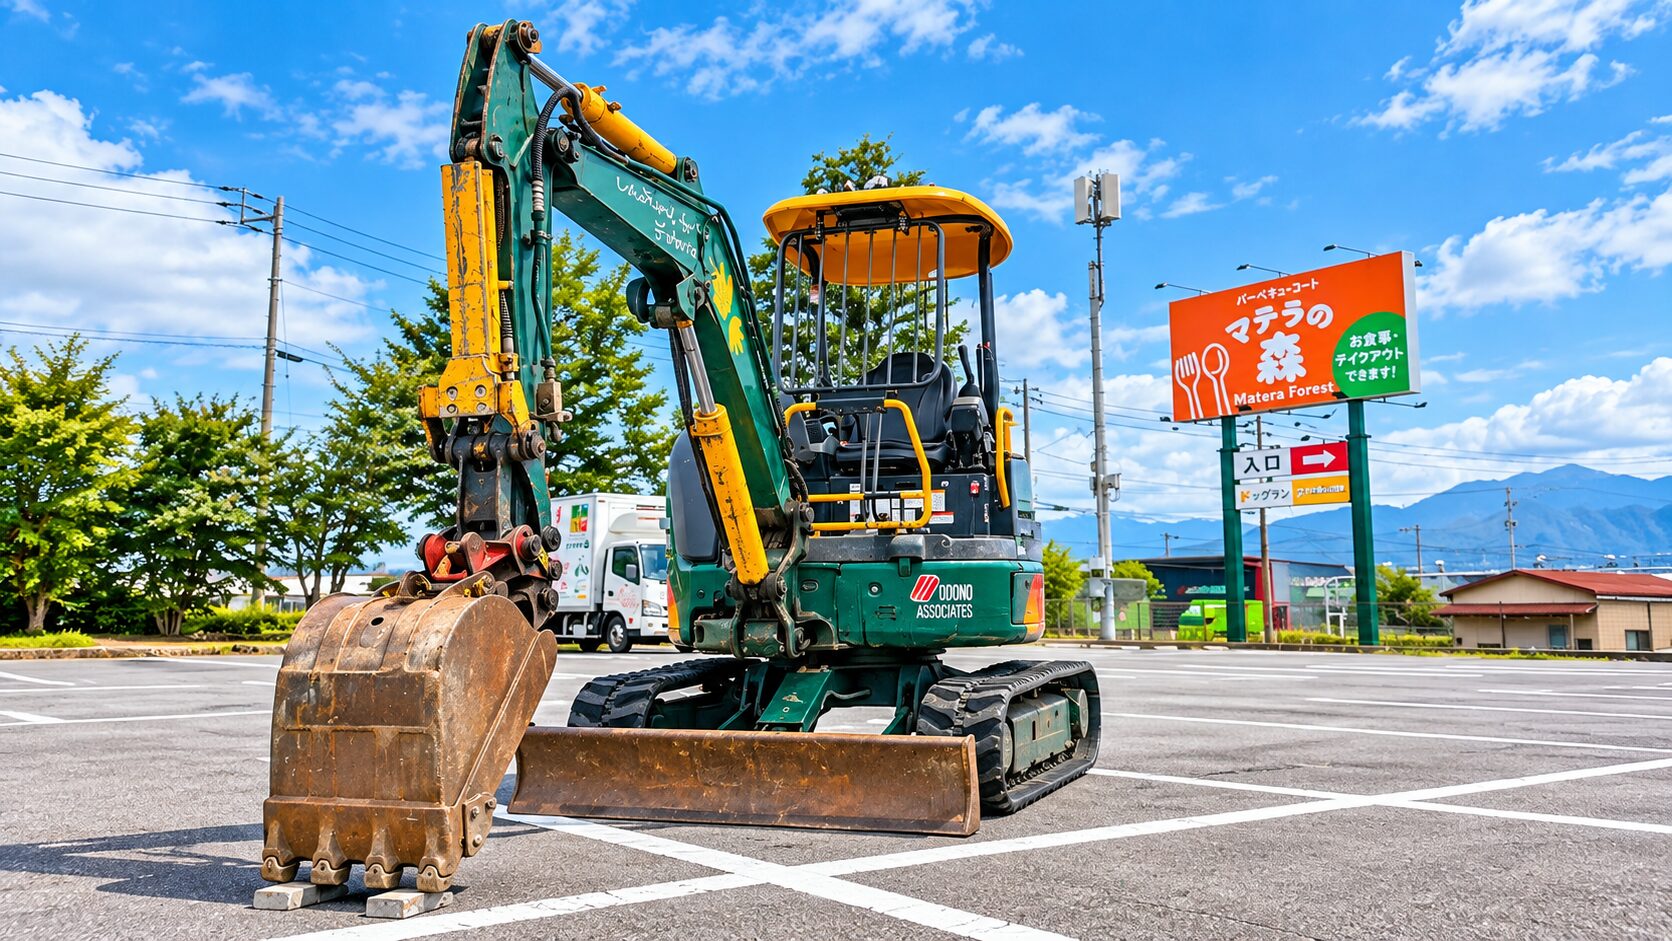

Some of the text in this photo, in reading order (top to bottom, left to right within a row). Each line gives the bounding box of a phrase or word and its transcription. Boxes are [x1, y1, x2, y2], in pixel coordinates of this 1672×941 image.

[1225, 299, 1334, 344] マテラの
[1256, 331, 1307, 385] 森
[1334, 347, 1404, 367] テイクアウト
[1233, 381, 1335, 406] Matera Forest
[1243, 455, 1280, 474] 入口
[1240, 488, 1290, 503] ドッグラン
[938, 583, 973, 601] ODONO
[916, 603, 973, 619] ASSOCIATES
